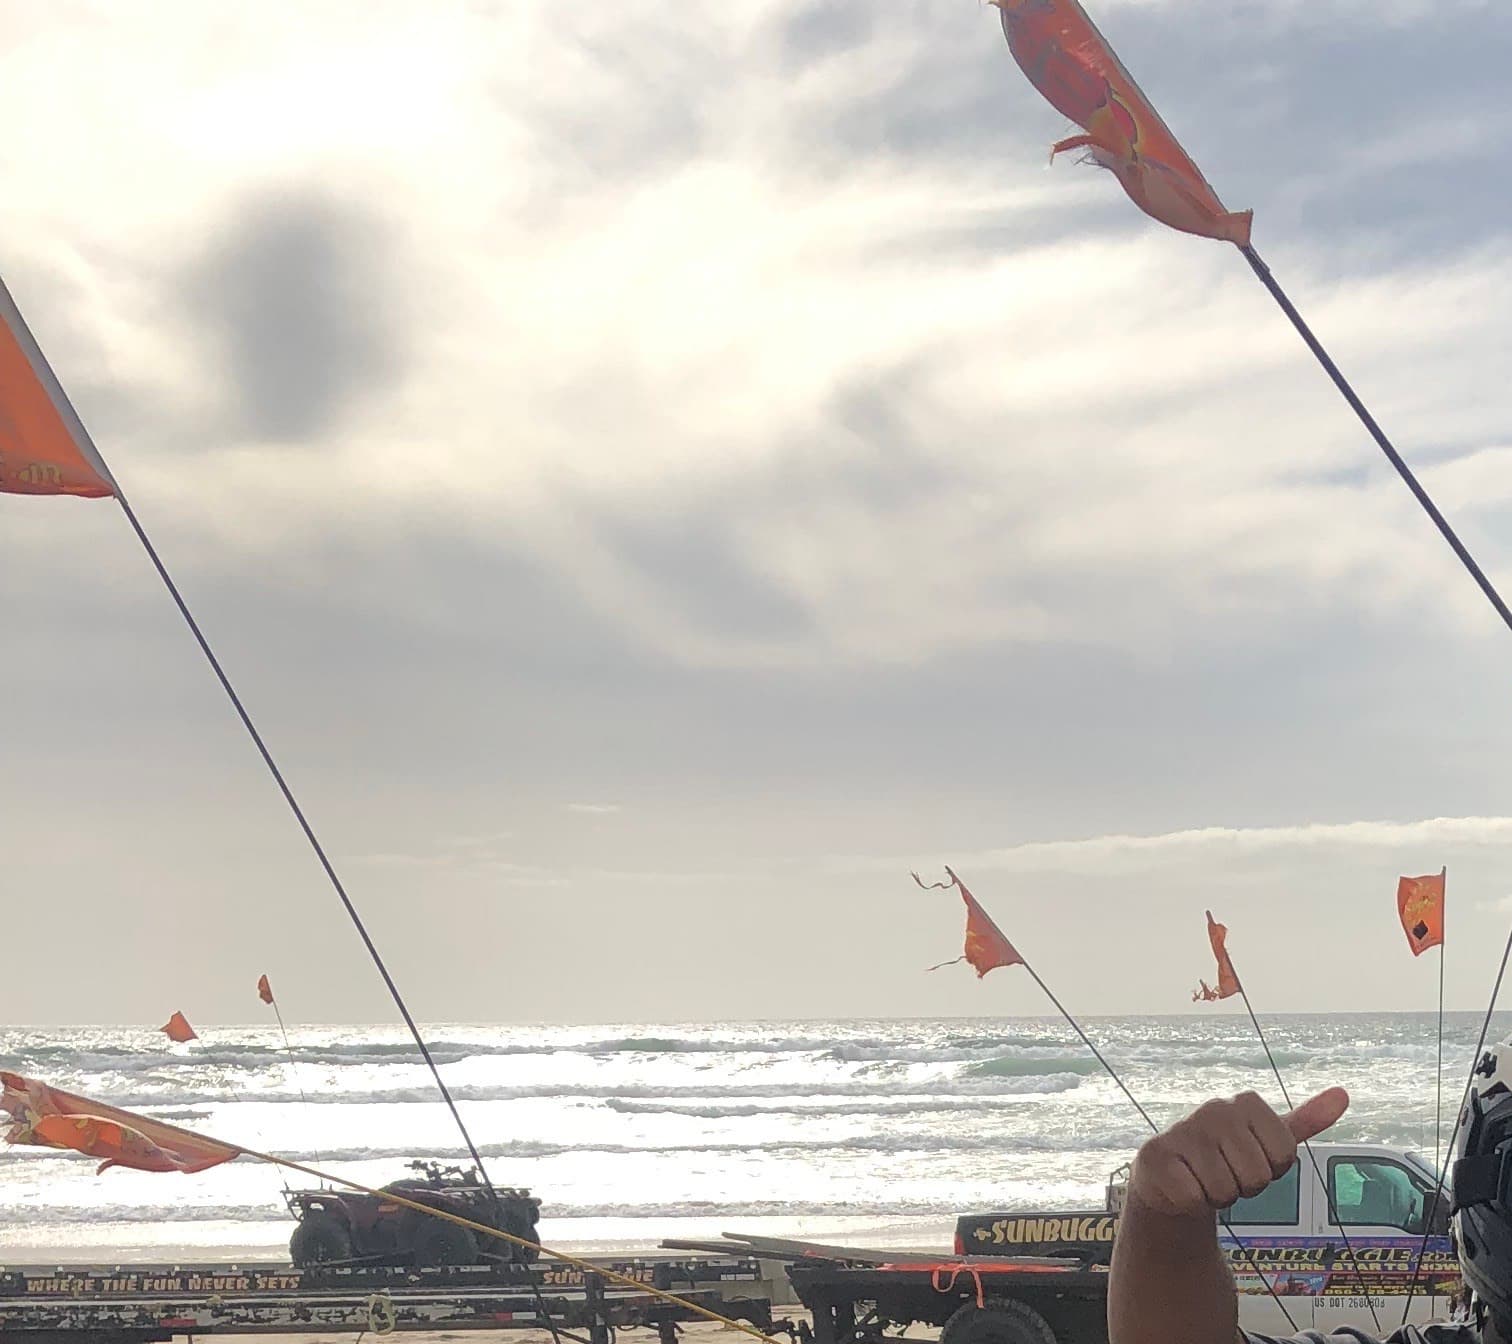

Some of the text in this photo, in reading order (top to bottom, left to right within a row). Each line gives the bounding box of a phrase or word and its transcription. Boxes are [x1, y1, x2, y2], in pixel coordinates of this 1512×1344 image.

[27, 1275, 300, 1292] WHERE THE FUN NEVER SETS
[1329, 1297, 1345, 1308] DOT
